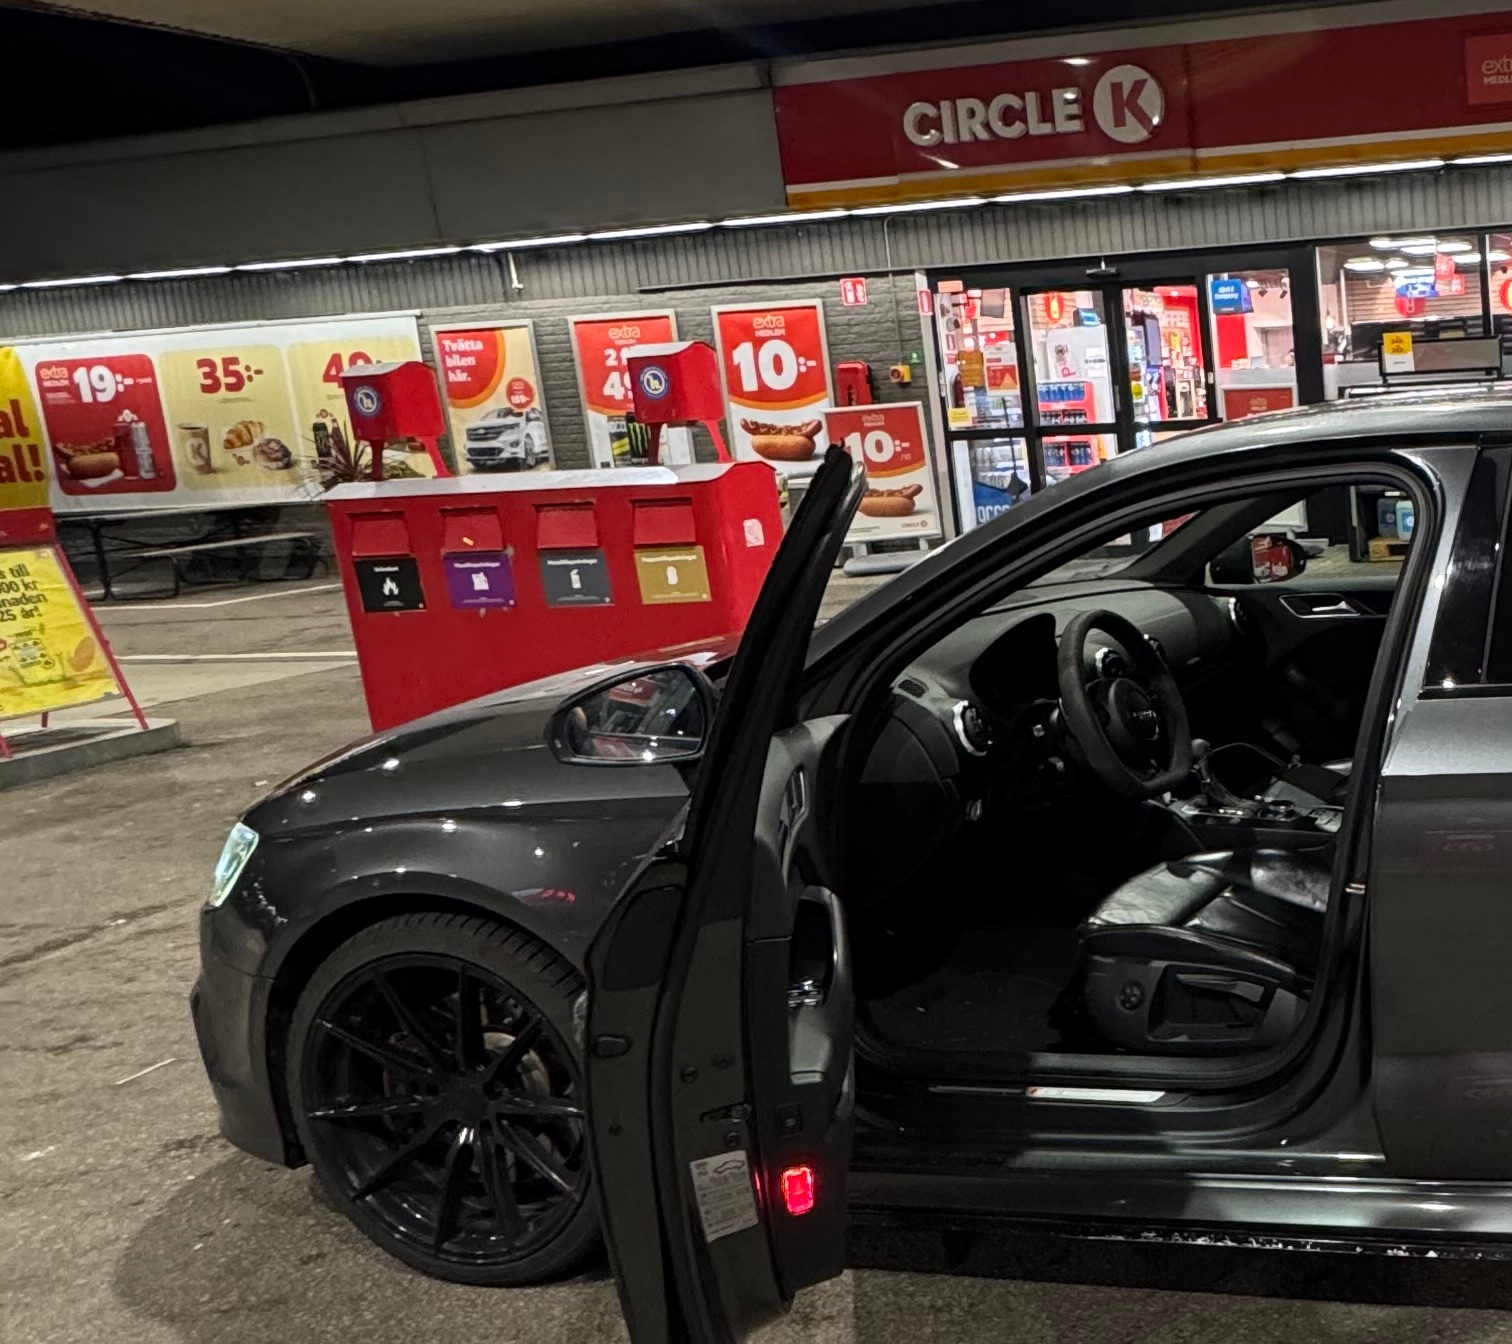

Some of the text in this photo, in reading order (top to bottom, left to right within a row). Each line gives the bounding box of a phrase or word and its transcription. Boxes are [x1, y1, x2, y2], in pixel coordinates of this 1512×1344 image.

[903, 74, 1156, 146] CIRCLE K
[752, 313, 785, 329] extra
[608, 323, 641, 340] extra
[442, 339, 484, 353] Tvätta
[445, 354, 477, 367] bilen
[604, 348, 619, 366] 2
[732, 339, 817, 392] 10:-
[196, 356, 264, 395] 35:-
[448, 369, 472, 382] här.
[73, 364, 134, 404] 19:-
[9, 563, 31, 578] till
[20, 578, 39, 592] kr
[20, 604, 43, 620] år!
